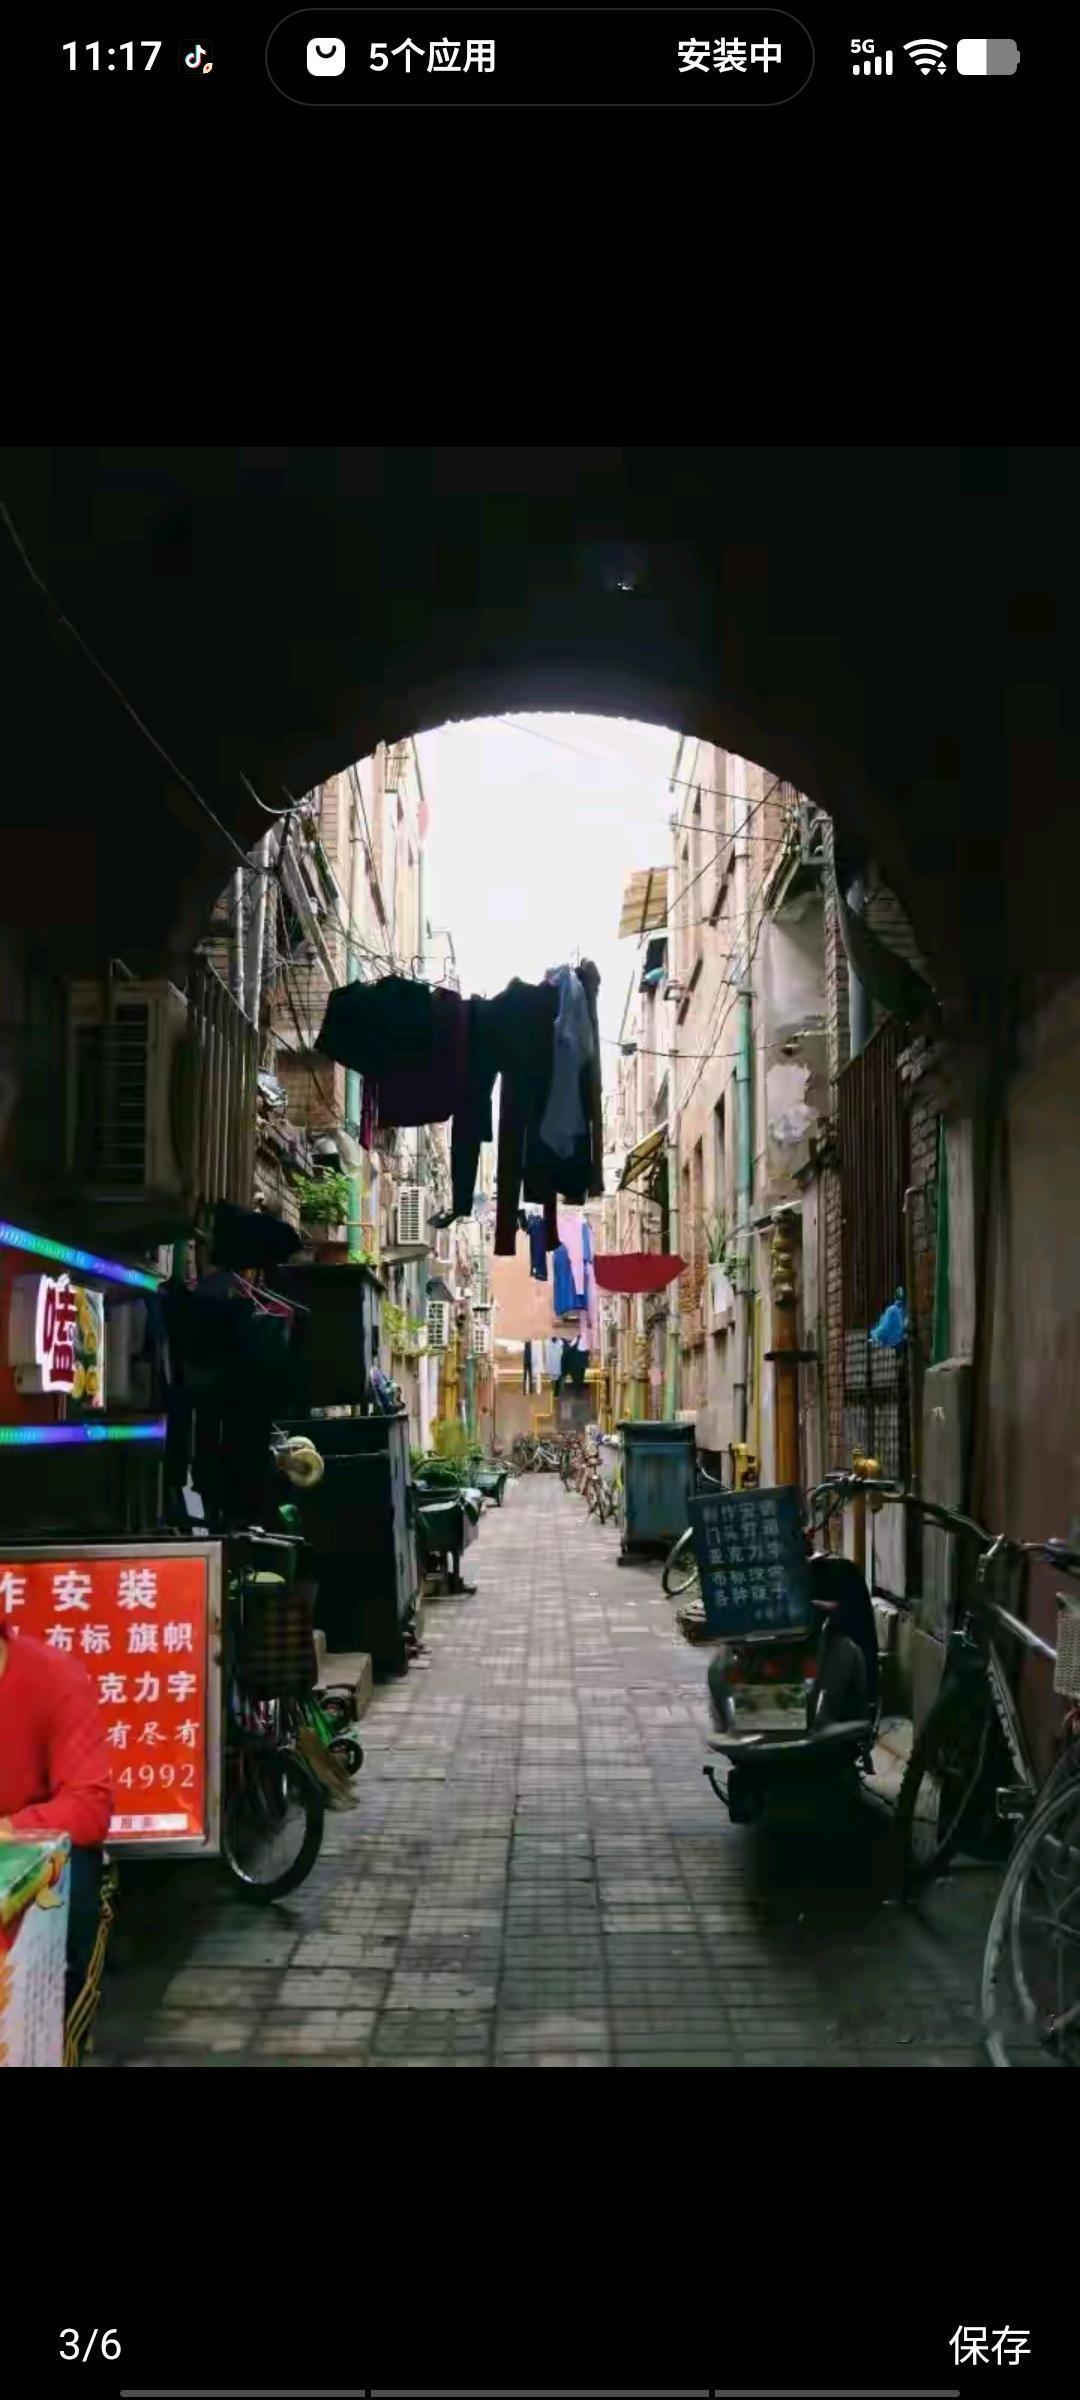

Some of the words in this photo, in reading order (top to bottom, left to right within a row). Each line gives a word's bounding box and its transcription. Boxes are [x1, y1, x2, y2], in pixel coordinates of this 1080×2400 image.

[45, 1623, 111, 1655] 布标
[126, 1620, 194, 1655] 旗帜
[87, 1670, 197, 1704] 克力字
[105, 1719, 200, 1750] 有尽有
[108, 1764, 195, 1789] 4992
